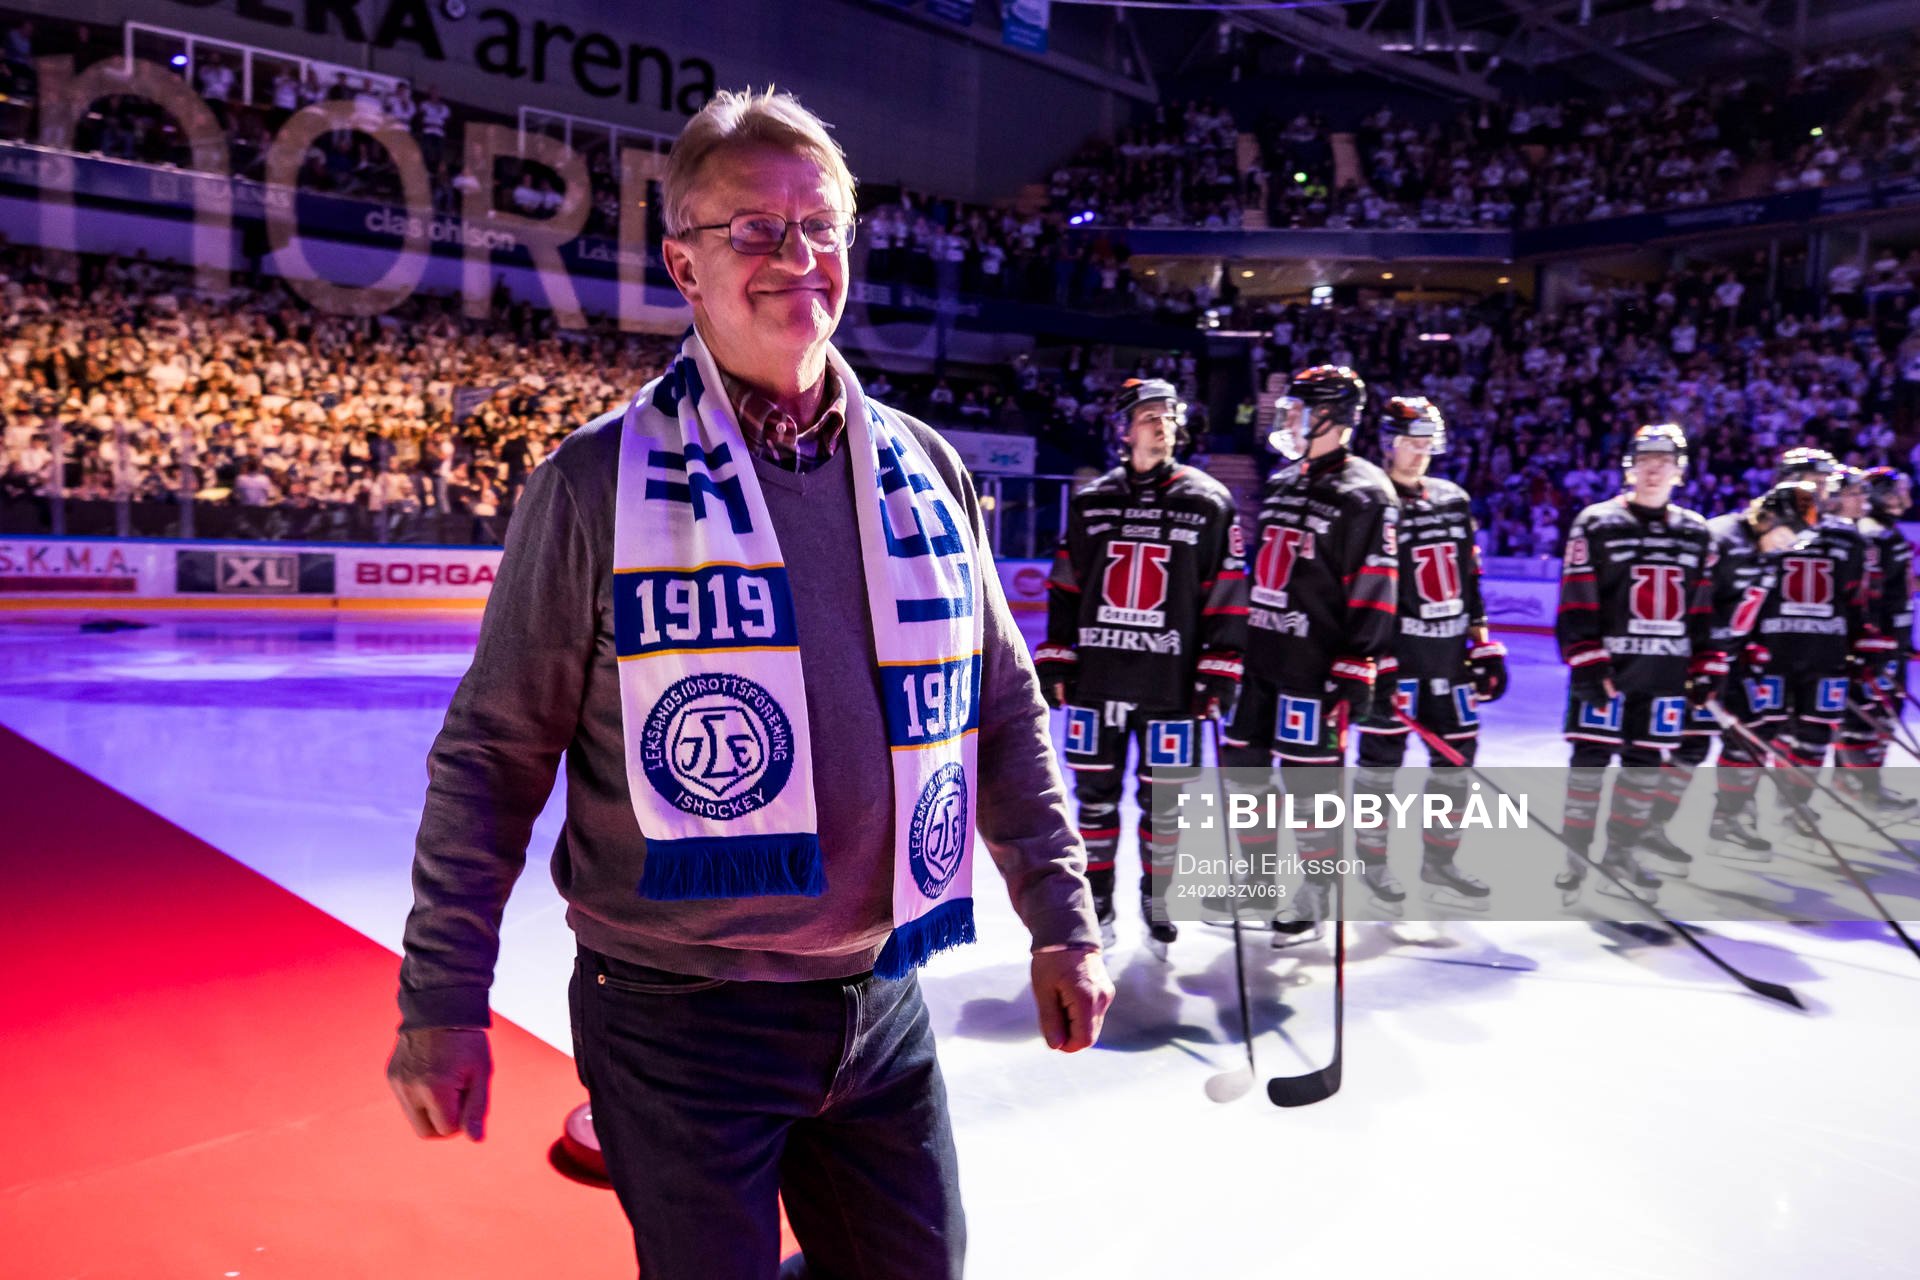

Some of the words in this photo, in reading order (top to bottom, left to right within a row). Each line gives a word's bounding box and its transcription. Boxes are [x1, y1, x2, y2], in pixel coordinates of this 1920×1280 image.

[475, 9, 715, 115] arena
[365, 209, 423, 239] clas
[428, 220, 516, 251] ohlson
[225, 558, 290, 587] XL
[355, 562, 495, 586] BORGA
[636, 574, 777, 646] 1919
[645, 689, 684, 769] LEKSANDS
[903, 664, 971, 738] 1919
[675, 788, 765, 818] ISHOCKEY
